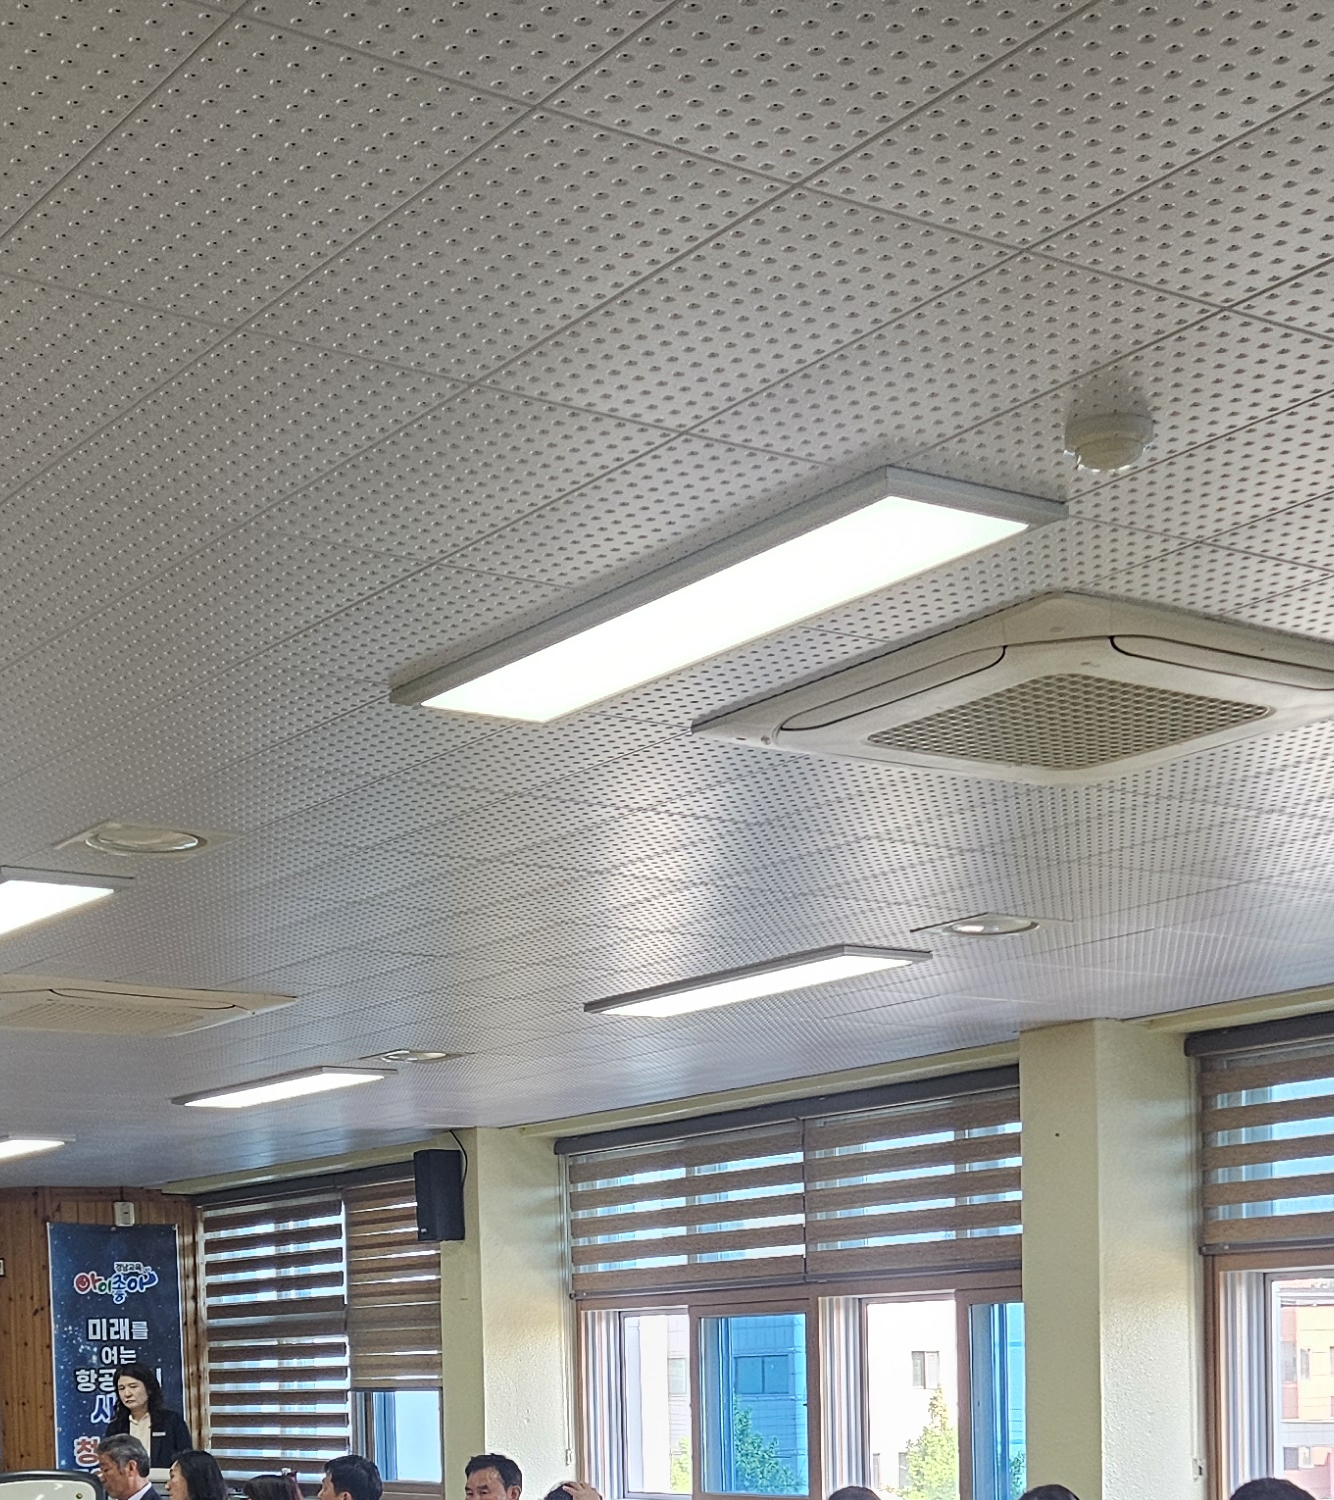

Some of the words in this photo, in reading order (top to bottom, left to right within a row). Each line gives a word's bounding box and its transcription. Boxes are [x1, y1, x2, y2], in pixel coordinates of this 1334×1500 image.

[74, 1271, 158, 1304] 아이좋아
[87, 1318, 149, 1341] 미래를
[101, 1346, 137, 1365] 여는
